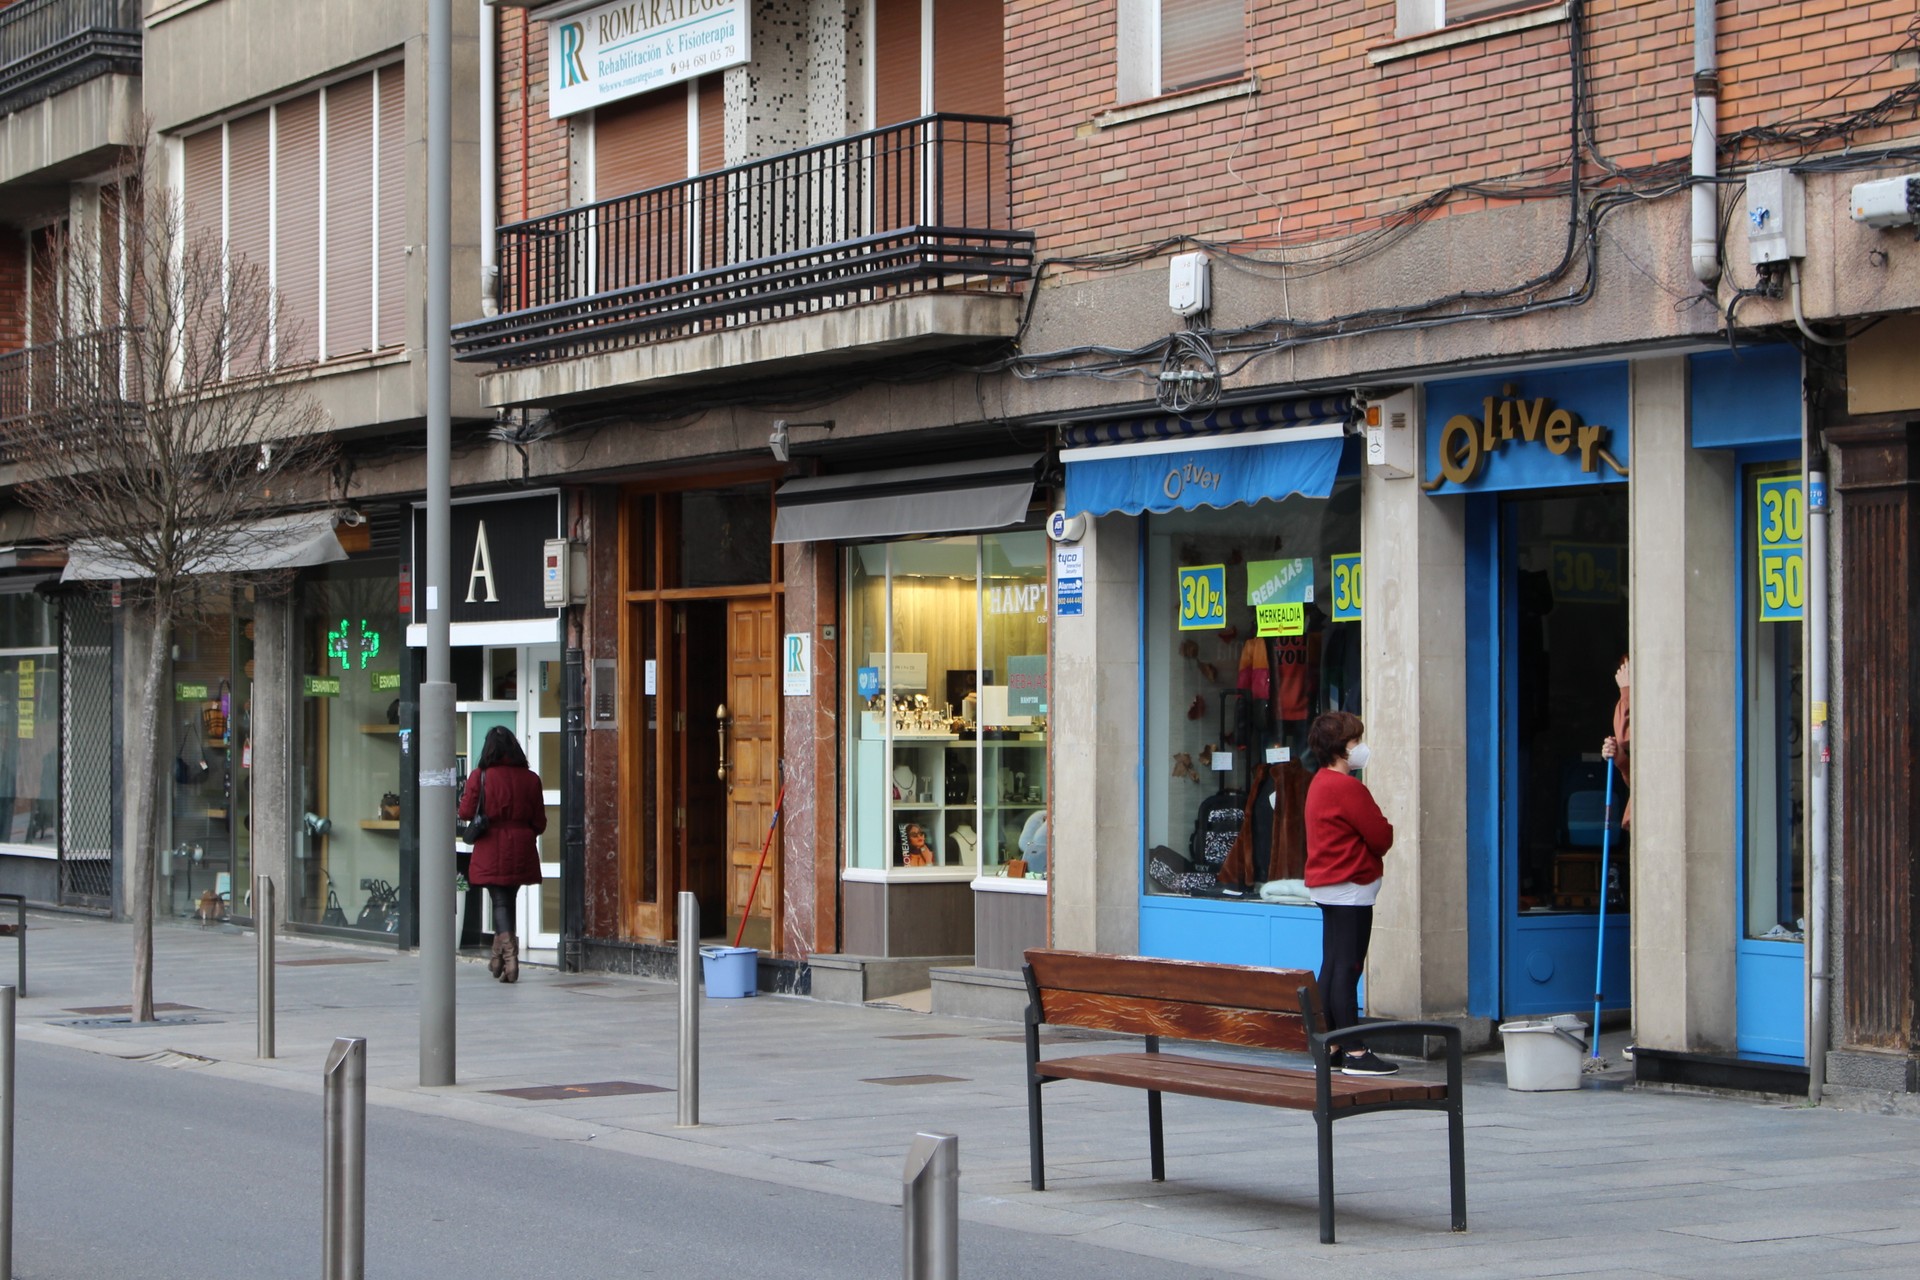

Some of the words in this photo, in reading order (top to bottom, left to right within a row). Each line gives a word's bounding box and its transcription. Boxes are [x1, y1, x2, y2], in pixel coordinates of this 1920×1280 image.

[598, 43, 661, 77] Rehabilitación
[665, 38, 674, 56] &
[678, 19, 735, 52] Fisioterapia
[679, 59, 690, 71] 94
[693, 53, 707, 67] 681
[710, 48, 722, 62] 05
[725, 44, 735, 58] 79
[1440, 383, 1608, 484] Oliver
[1763, 488, 1803, 543] 30
[464, 519, 500, 603] A
[1058, 553, 1077, 565] tyco
[1251, 558, 1303, 606] REBAJAS
[1765, 555, 1803, 609] 50
[1182, 575, 1223, 619] 30%
[1259, 607, 1301, 624] MERKEALDIA
[1277, 649, 1306, 665] YOU
